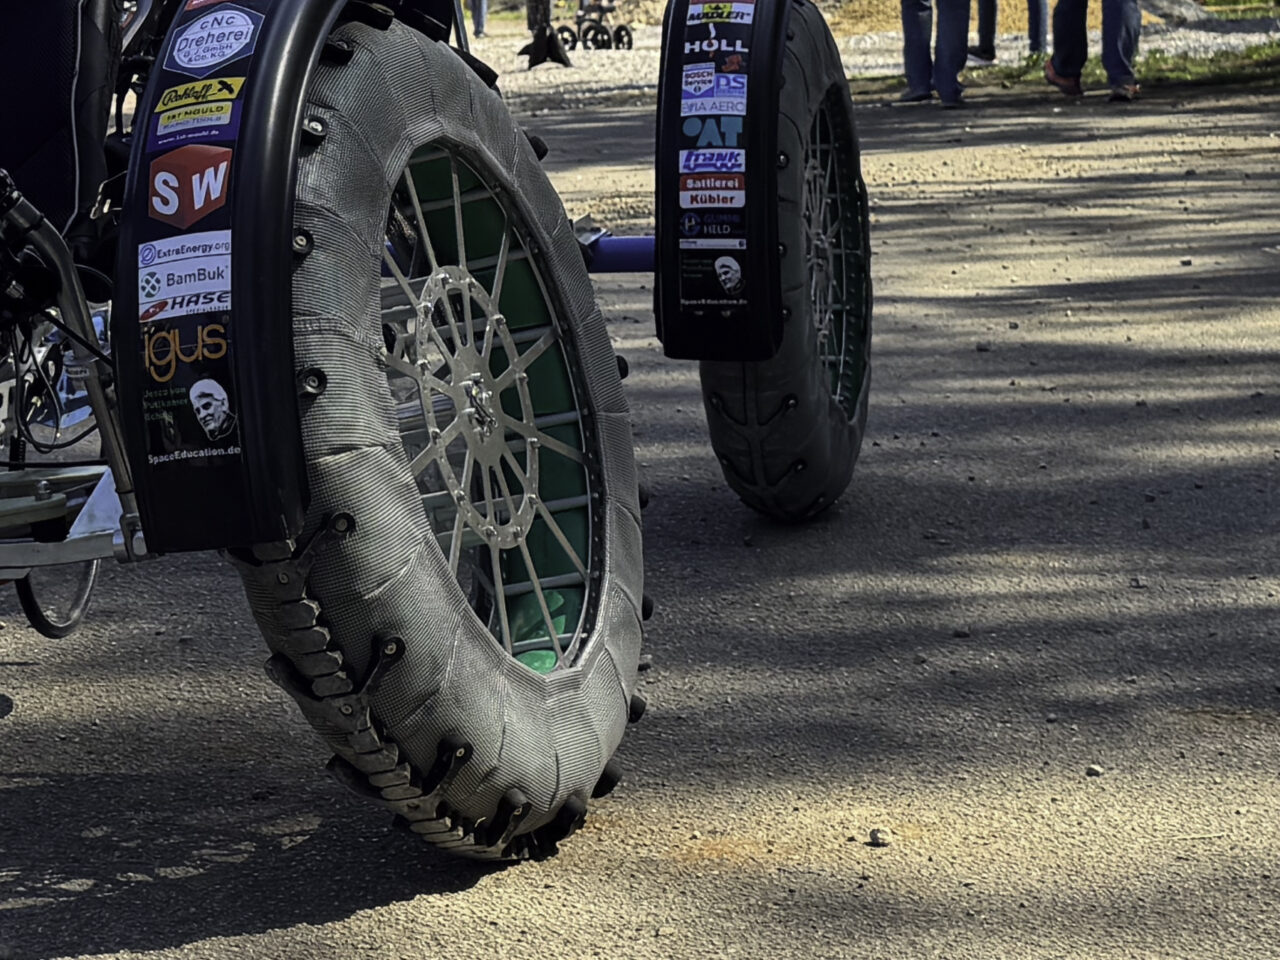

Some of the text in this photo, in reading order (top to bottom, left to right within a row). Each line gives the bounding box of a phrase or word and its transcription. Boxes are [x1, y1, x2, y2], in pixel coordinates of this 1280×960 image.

[177, 27, 250, 53] Dreherei
[684, 39, 749, 54] HOLL
[686, 178, 739, 189] Sattlerei
[690, 193, 735, 205] Kübler
[157, 242, 230, 259] ExtraEnergy.org
[166, 266, 225, 288] BamBuk
[171, 291, 230, 310] HASE
[144, 324, 228, 382] igus
[148, 445, 241, 465] SpaceEducation.de
